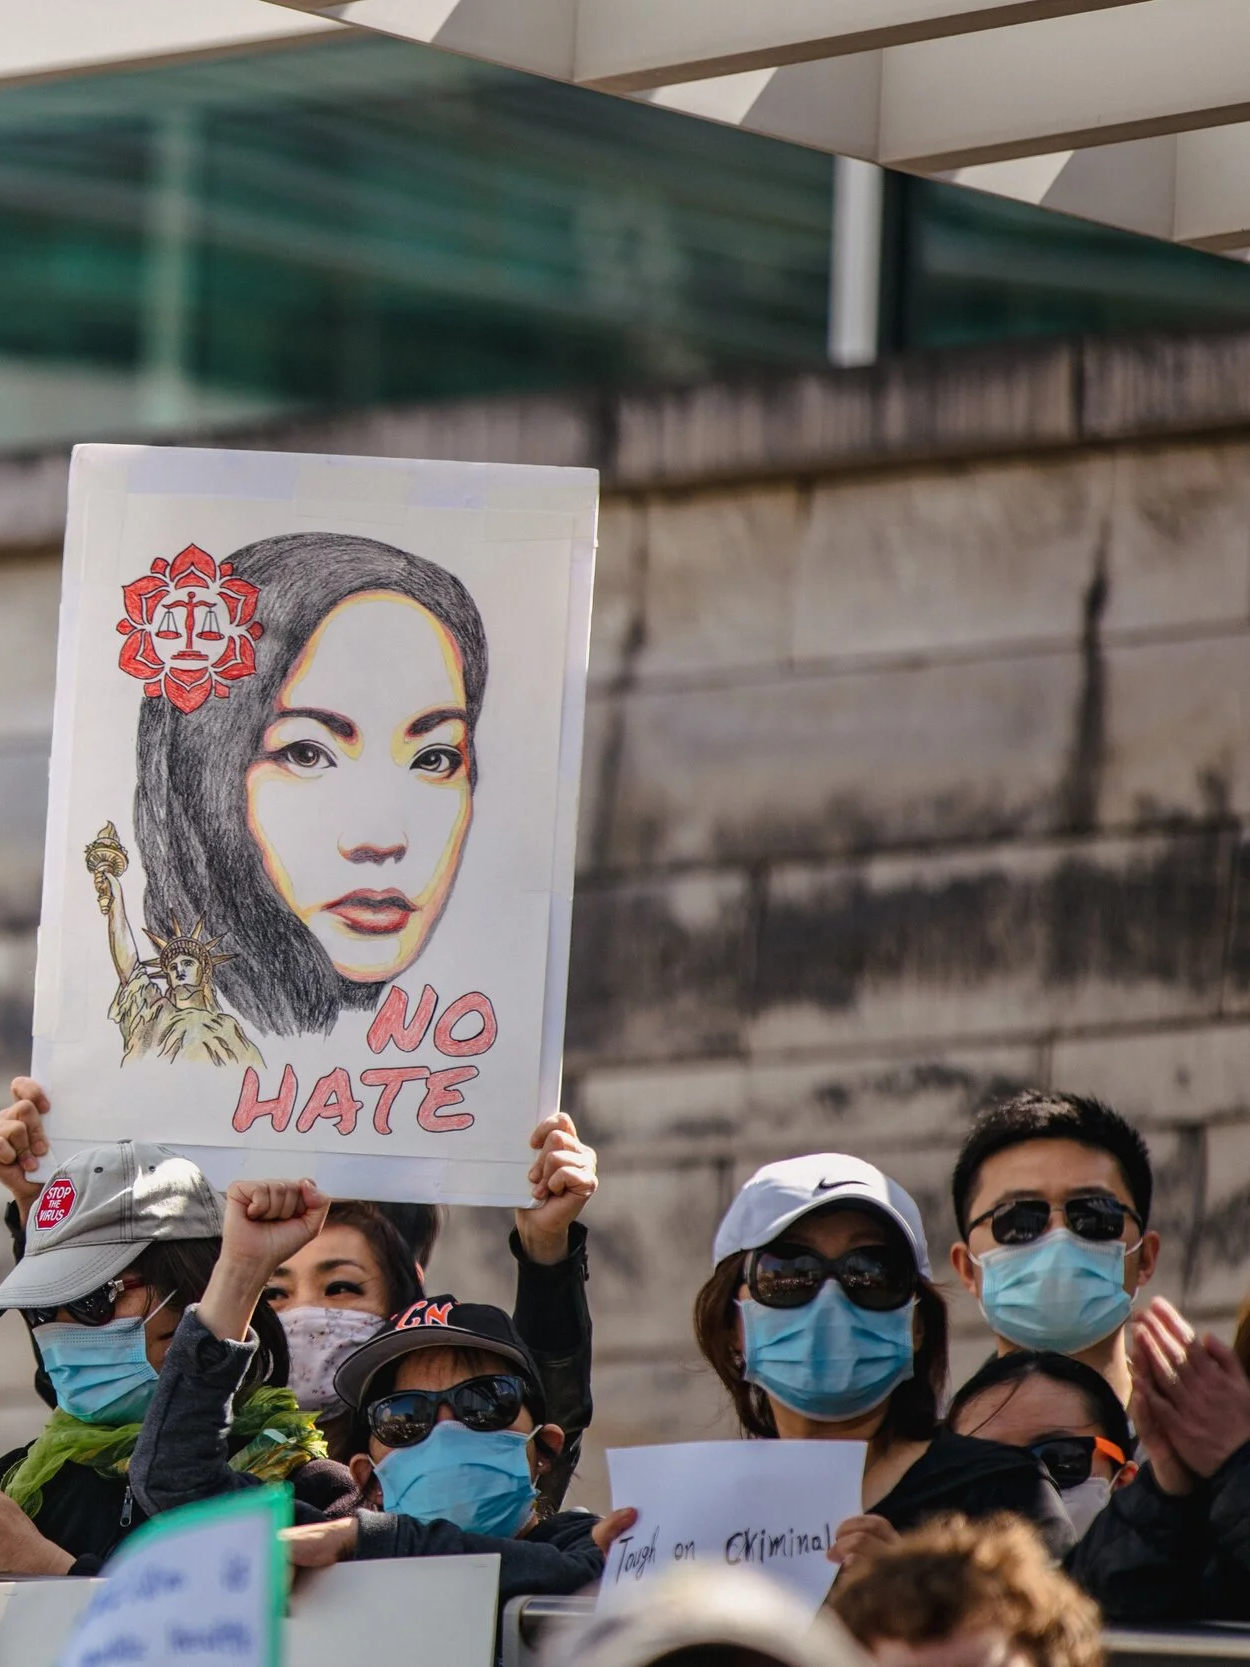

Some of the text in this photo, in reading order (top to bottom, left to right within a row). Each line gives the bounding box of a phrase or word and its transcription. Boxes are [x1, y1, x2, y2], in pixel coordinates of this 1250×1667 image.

[366, 983, 498, 1058] NO
[231, 1063, 480, 1136] HATE
[46, 1186, 72, 1200] STOP
[48, 1199, 62, 1209] THE
[39, 1208, 65, 1222] VIRUS
[615, 1525, 660, 1585] Tough
[674, 1540, 695, 1561] on
